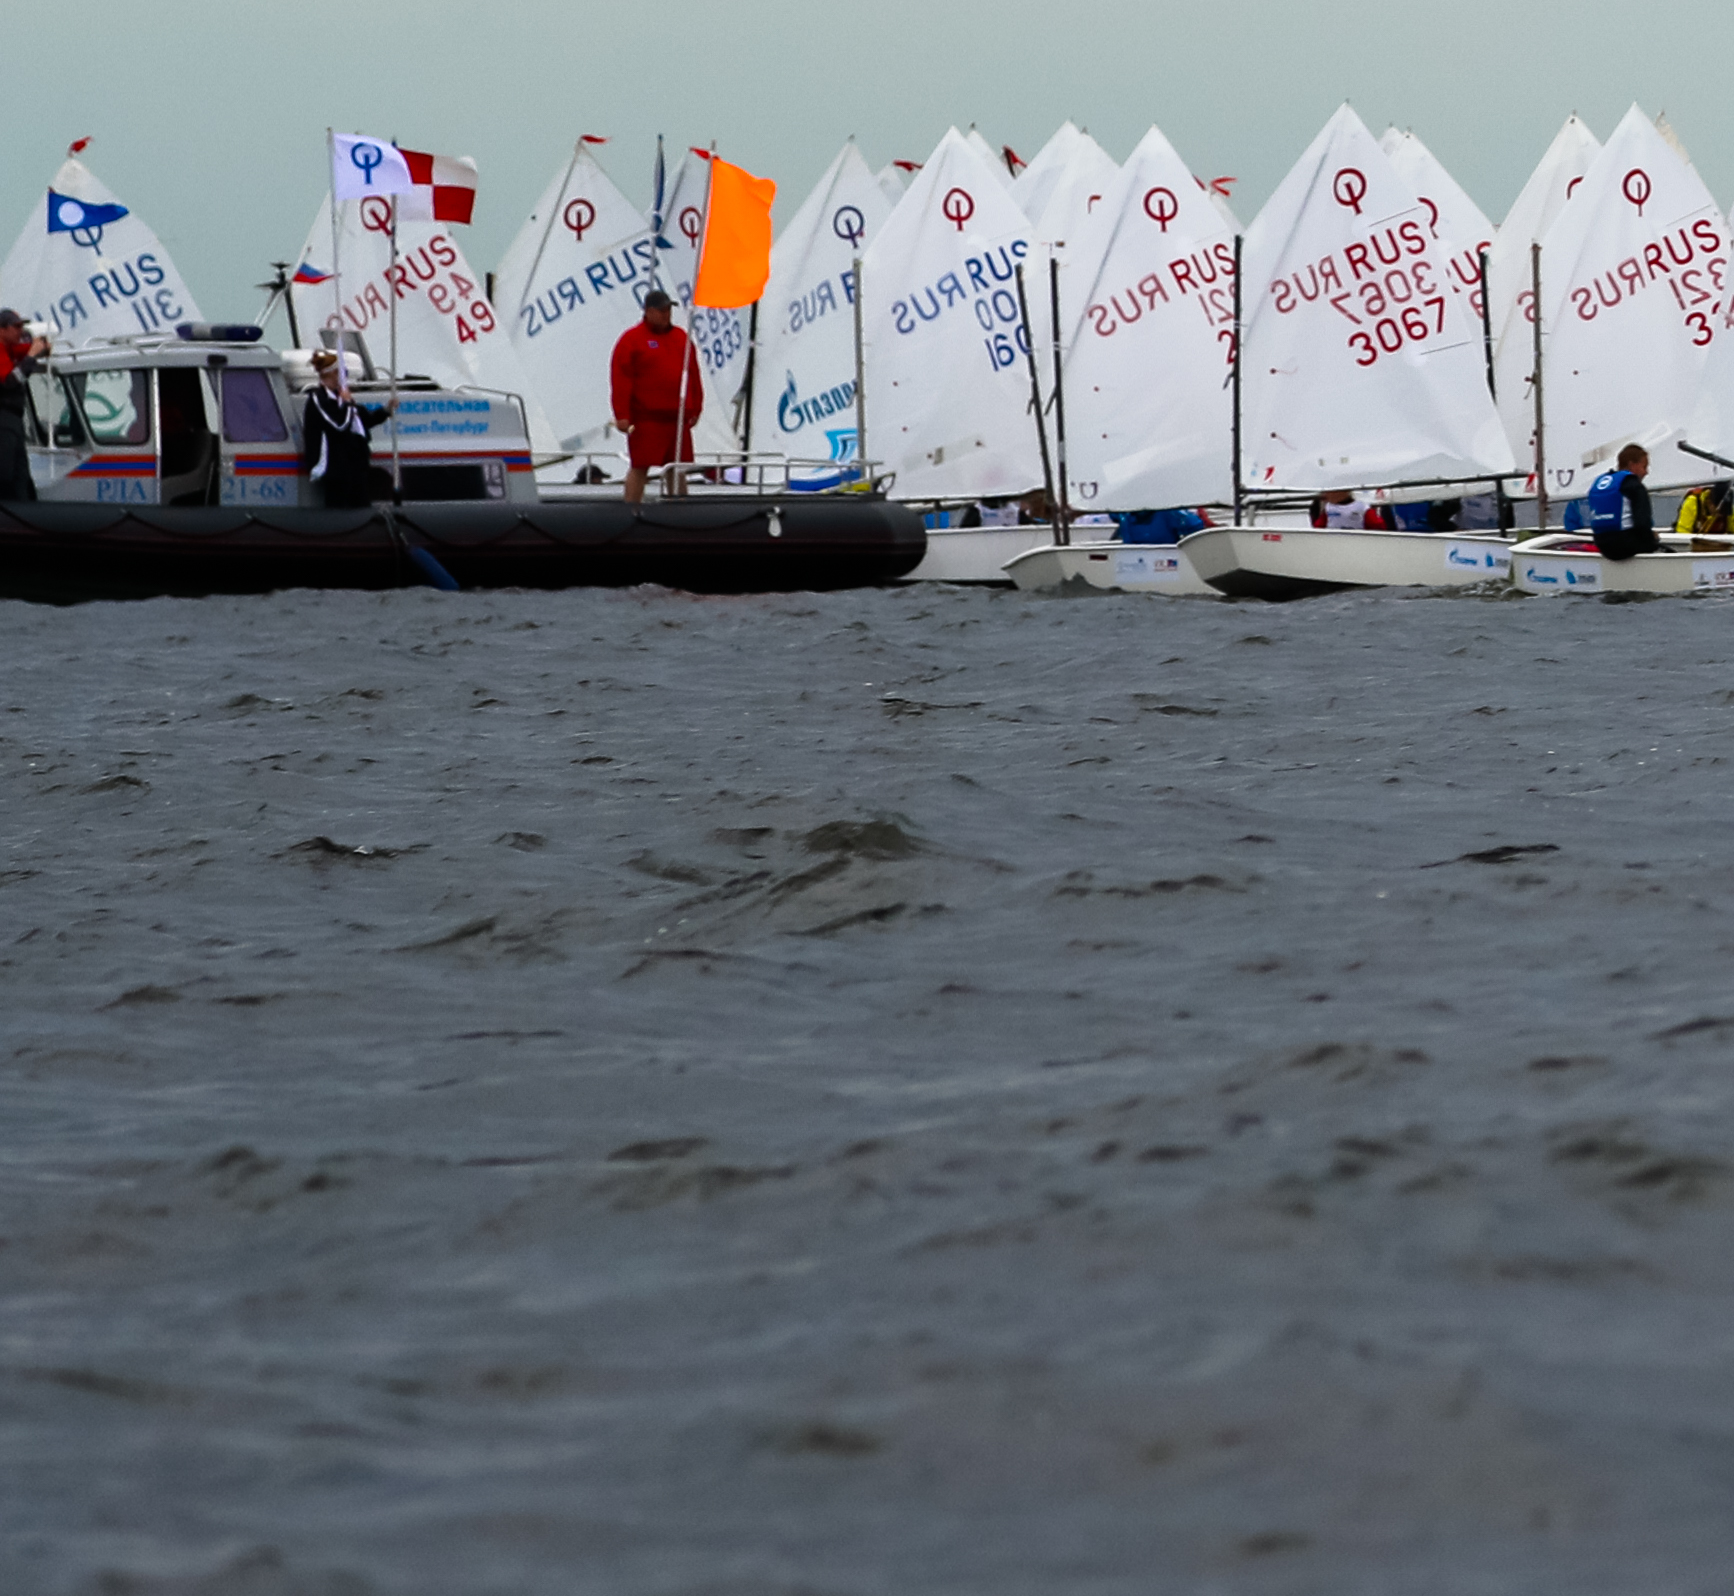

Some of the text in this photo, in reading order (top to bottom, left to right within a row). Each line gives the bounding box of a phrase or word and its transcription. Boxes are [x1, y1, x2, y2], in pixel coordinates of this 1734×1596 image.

[384, 234, 456, 299] RUS
[585, 240, 660, 290] RUS
[1169, 243, 1236, 294] RUS
[1344, 220, 1427, 281] RUS
[1644, 219, 1720, 281] RUS
[88, 254, 165, 308] RUS
[456, 301, 495, 344] 49
[1348, 296, 1445, 367] 3067
[223, 477, 287, 501] 21-68
